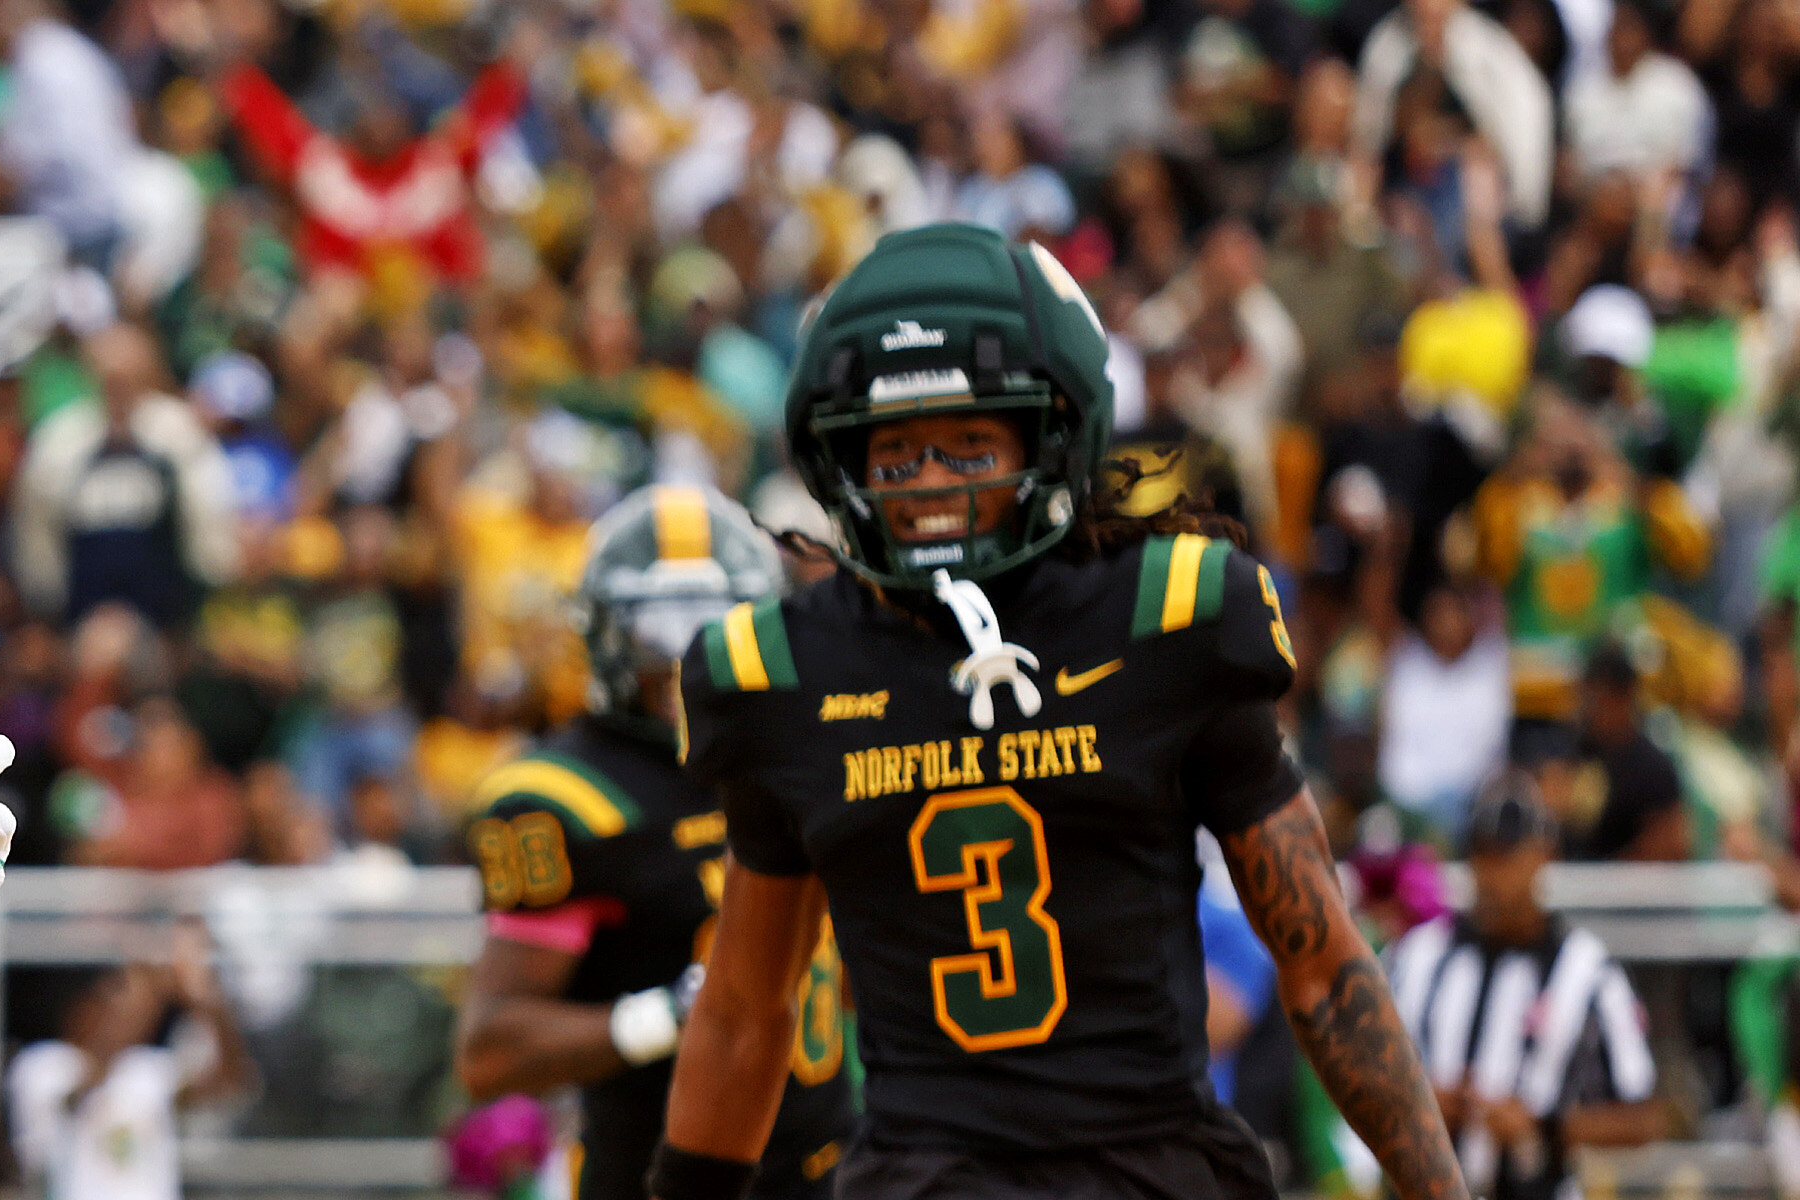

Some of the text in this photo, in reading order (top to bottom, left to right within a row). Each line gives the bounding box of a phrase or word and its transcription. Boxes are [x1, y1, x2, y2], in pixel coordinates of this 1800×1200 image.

[843, 724, 1102, 802] NORFOLK STATE
[908, 785, 1068, 1053] 3
